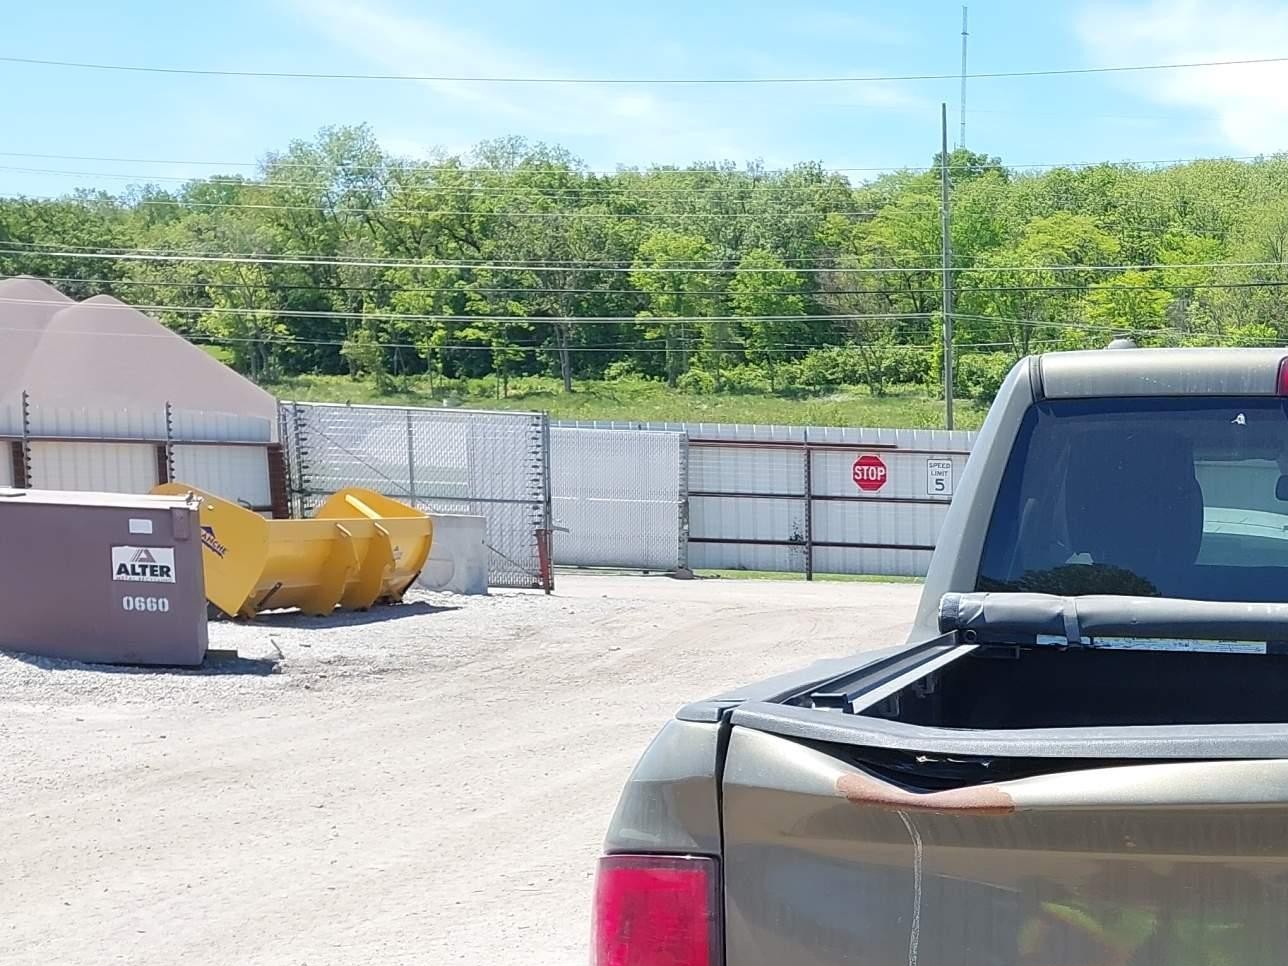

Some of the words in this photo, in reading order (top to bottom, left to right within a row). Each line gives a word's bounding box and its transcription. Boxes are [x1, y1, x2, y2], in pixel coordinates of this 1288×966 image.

[854, 465, 885, 480] STOP
[935, 479, 945, 491] 5
[116, 563, 171, 577] ALTER
[122, 595, 169, 612] 0660
